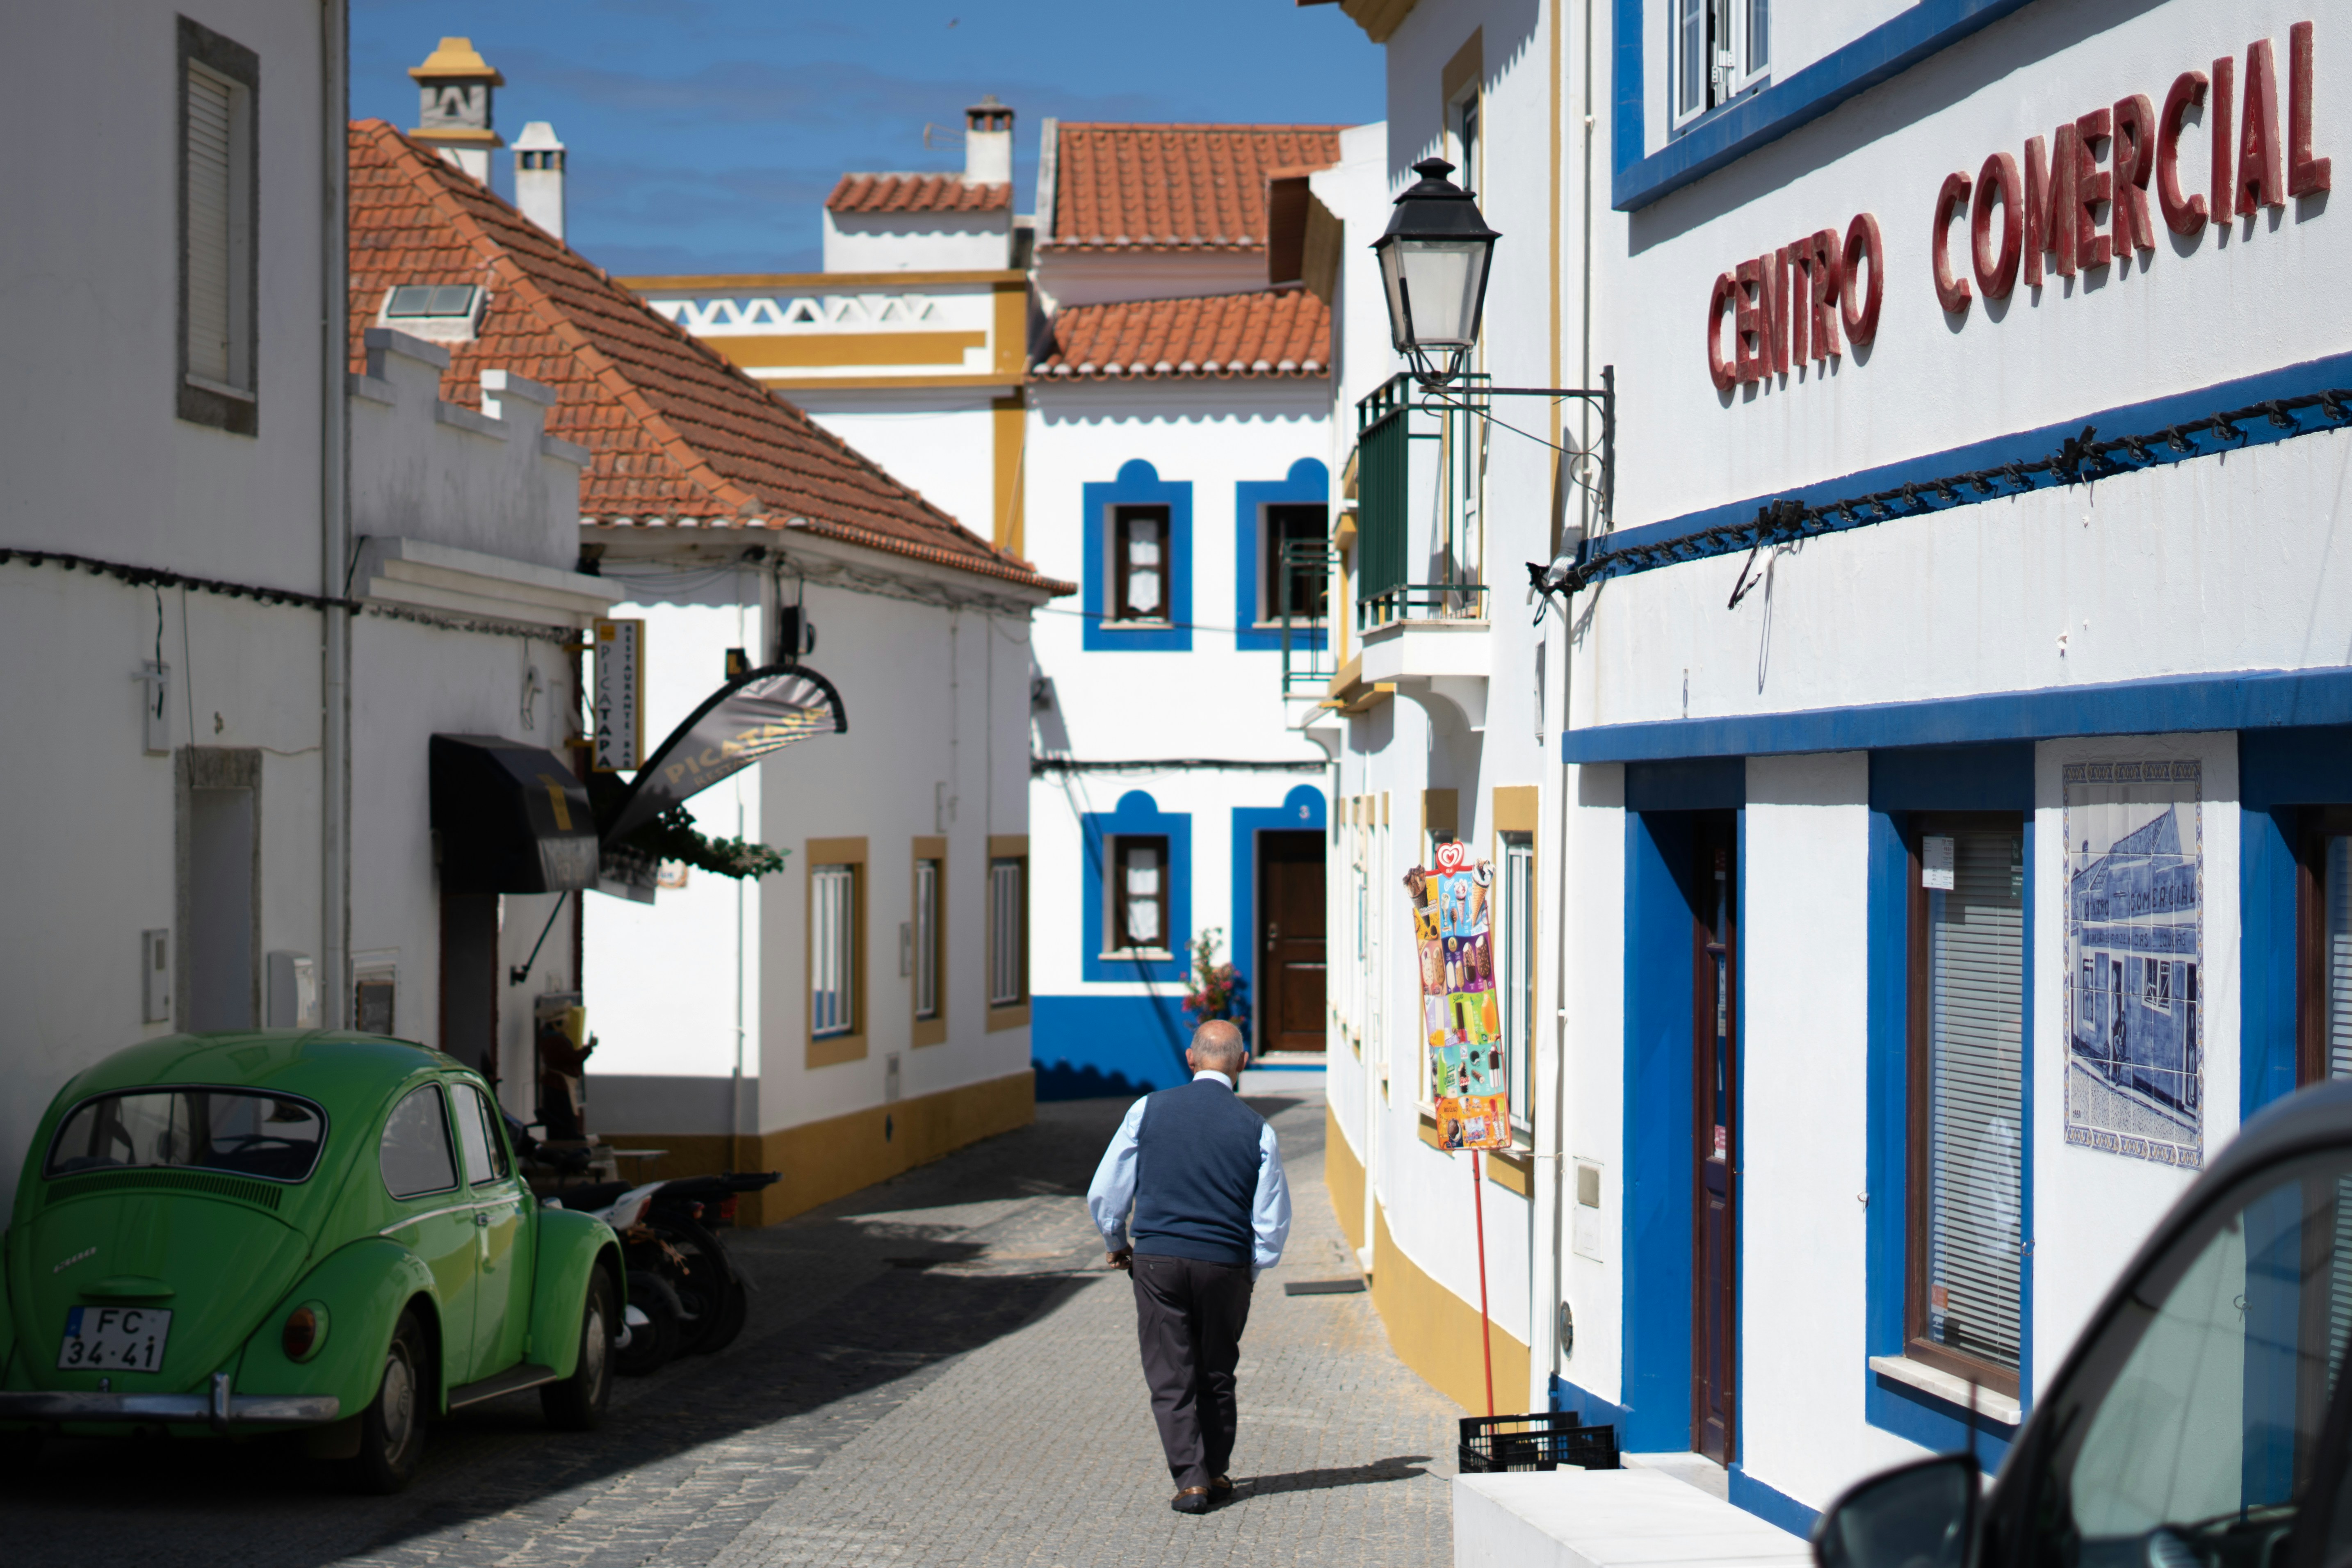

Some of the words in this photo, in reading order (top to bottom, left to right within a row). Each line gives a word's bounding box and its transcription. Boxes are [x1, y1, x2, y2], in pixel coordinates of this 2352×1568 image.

[1707, 212, 1883, 392] CENTRO
[1932, 20, 2331, 314] COMERCIAL
[598, 644, 612, 768] PICATAPA
[1298, 805, 1310, 819] 3
[2130, 881, 2195, 911] COMERCIAL
[97, 1310, 143, 1335] FC
